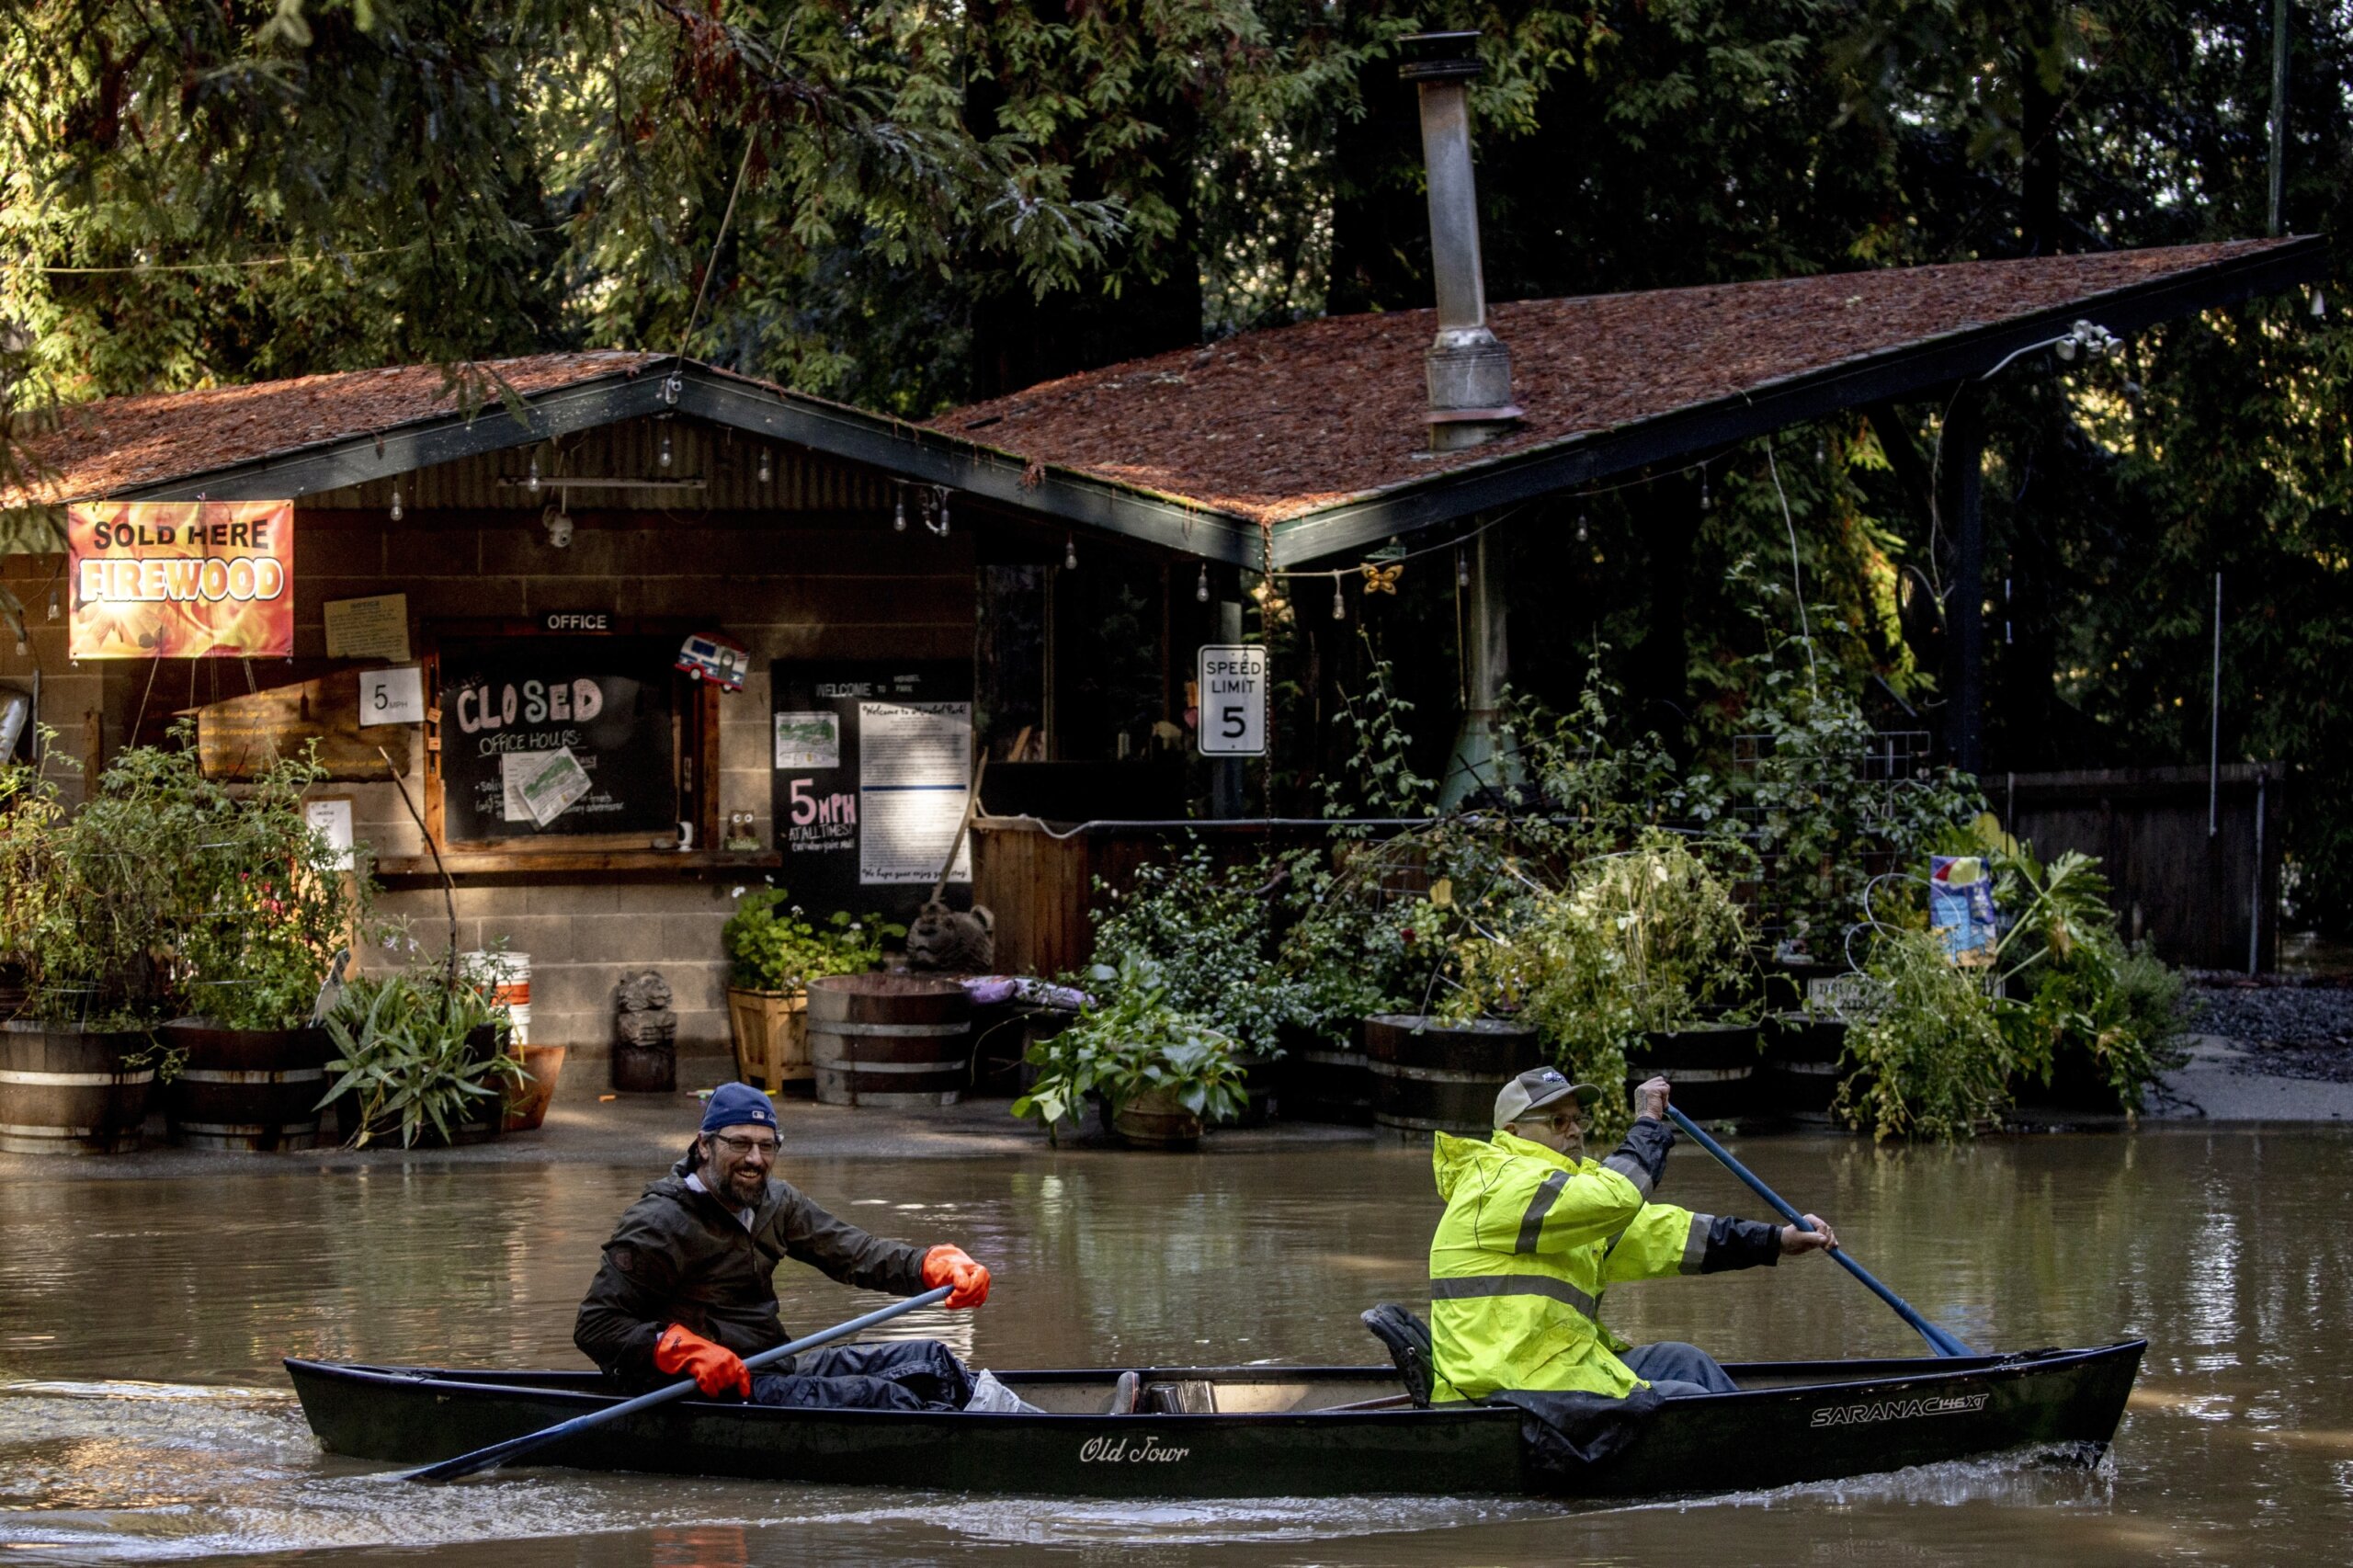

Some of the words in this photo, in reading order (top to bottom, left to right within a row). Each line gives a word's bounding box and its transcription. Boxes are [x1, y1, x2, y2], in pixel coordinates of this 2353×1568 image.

[94, 521, 176, 550] SOLD
[188, 519, 268, 549] HERE
[80, 557, 283, 601] FIREWOOD
[547, 614, 608, 629] OFFICE
[1206, 662, 1261, 675] SPEED
[374, 684, 388, 710] 5
[1211, 681, 1256, 693] LIMIT
[458, 678, 603, 733] CLOSED
[1222, 706, 1246, 738] 5
[479, 733, 525, 755] OFFICE
[791, 778, 817, 825] 5
[818, 793, 857, 824] MPH
[1811, 1397, 1939, 1426] SARANAC
[1080, 1437, 1128, 1462] Old
